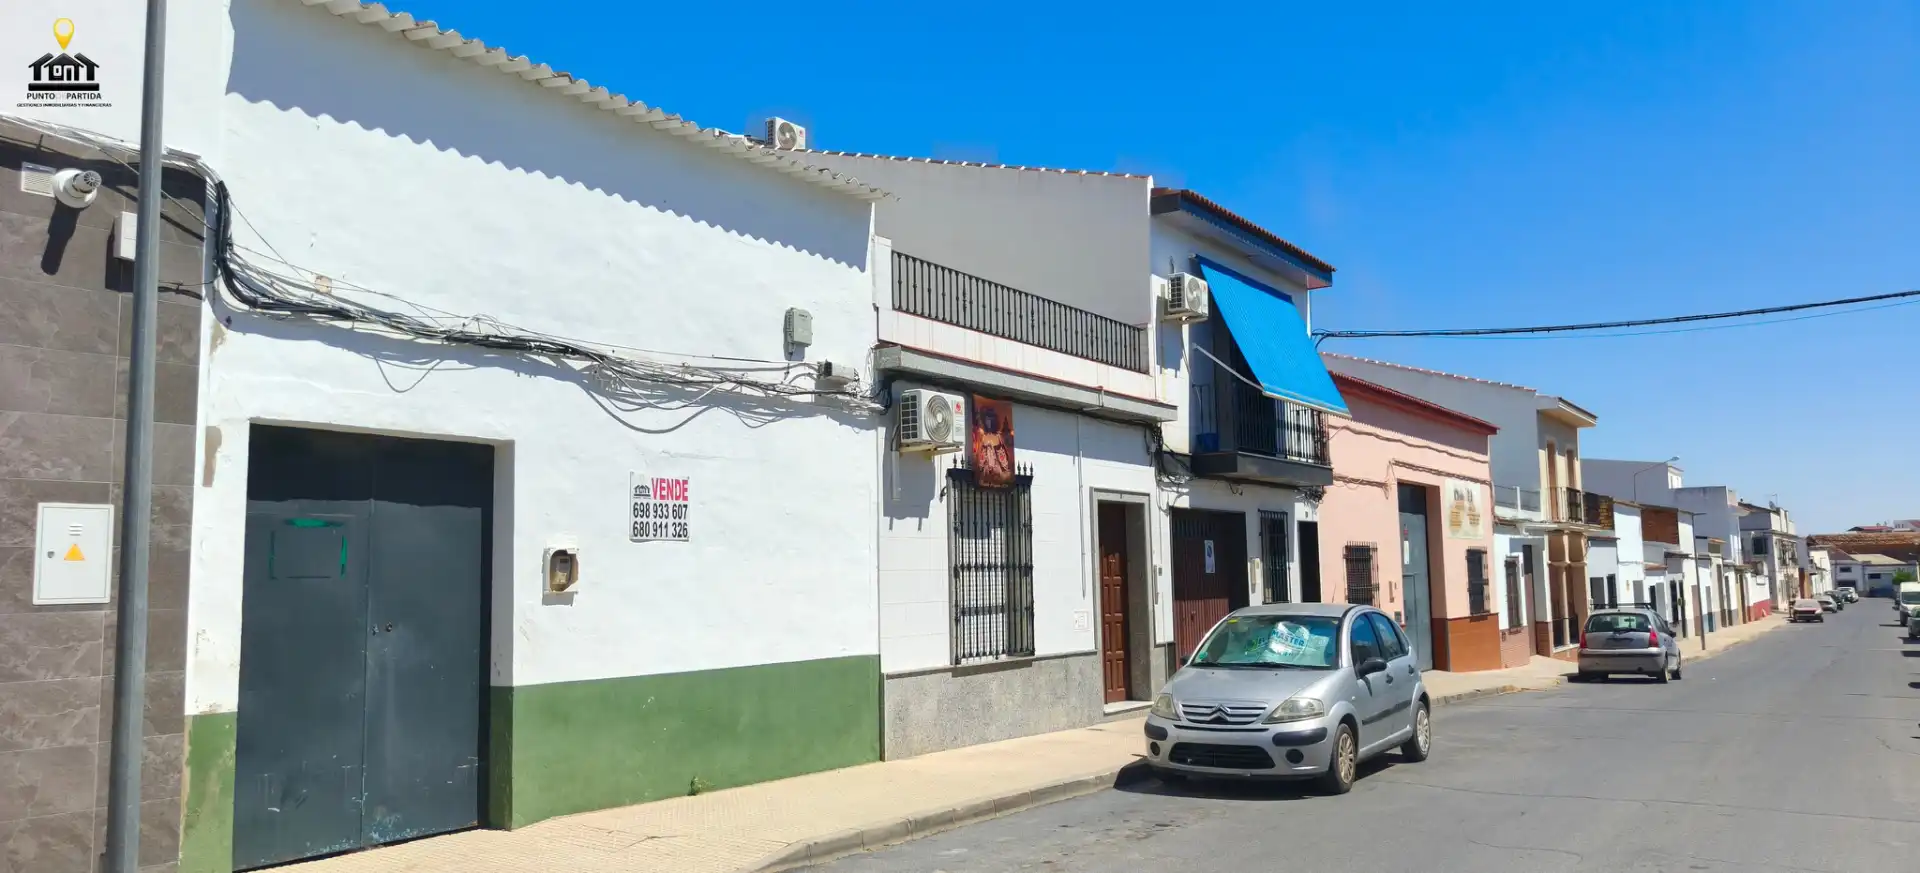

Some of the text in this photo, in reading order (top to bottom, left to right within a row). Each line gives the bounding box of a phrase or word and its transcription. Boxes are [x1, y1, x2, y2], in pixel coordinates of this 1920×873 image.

[651, 478, 688, 501] VENDE
[633, 502, 688, 520] 698 933 607
[633, 521, 688, 538] 680 911 326
